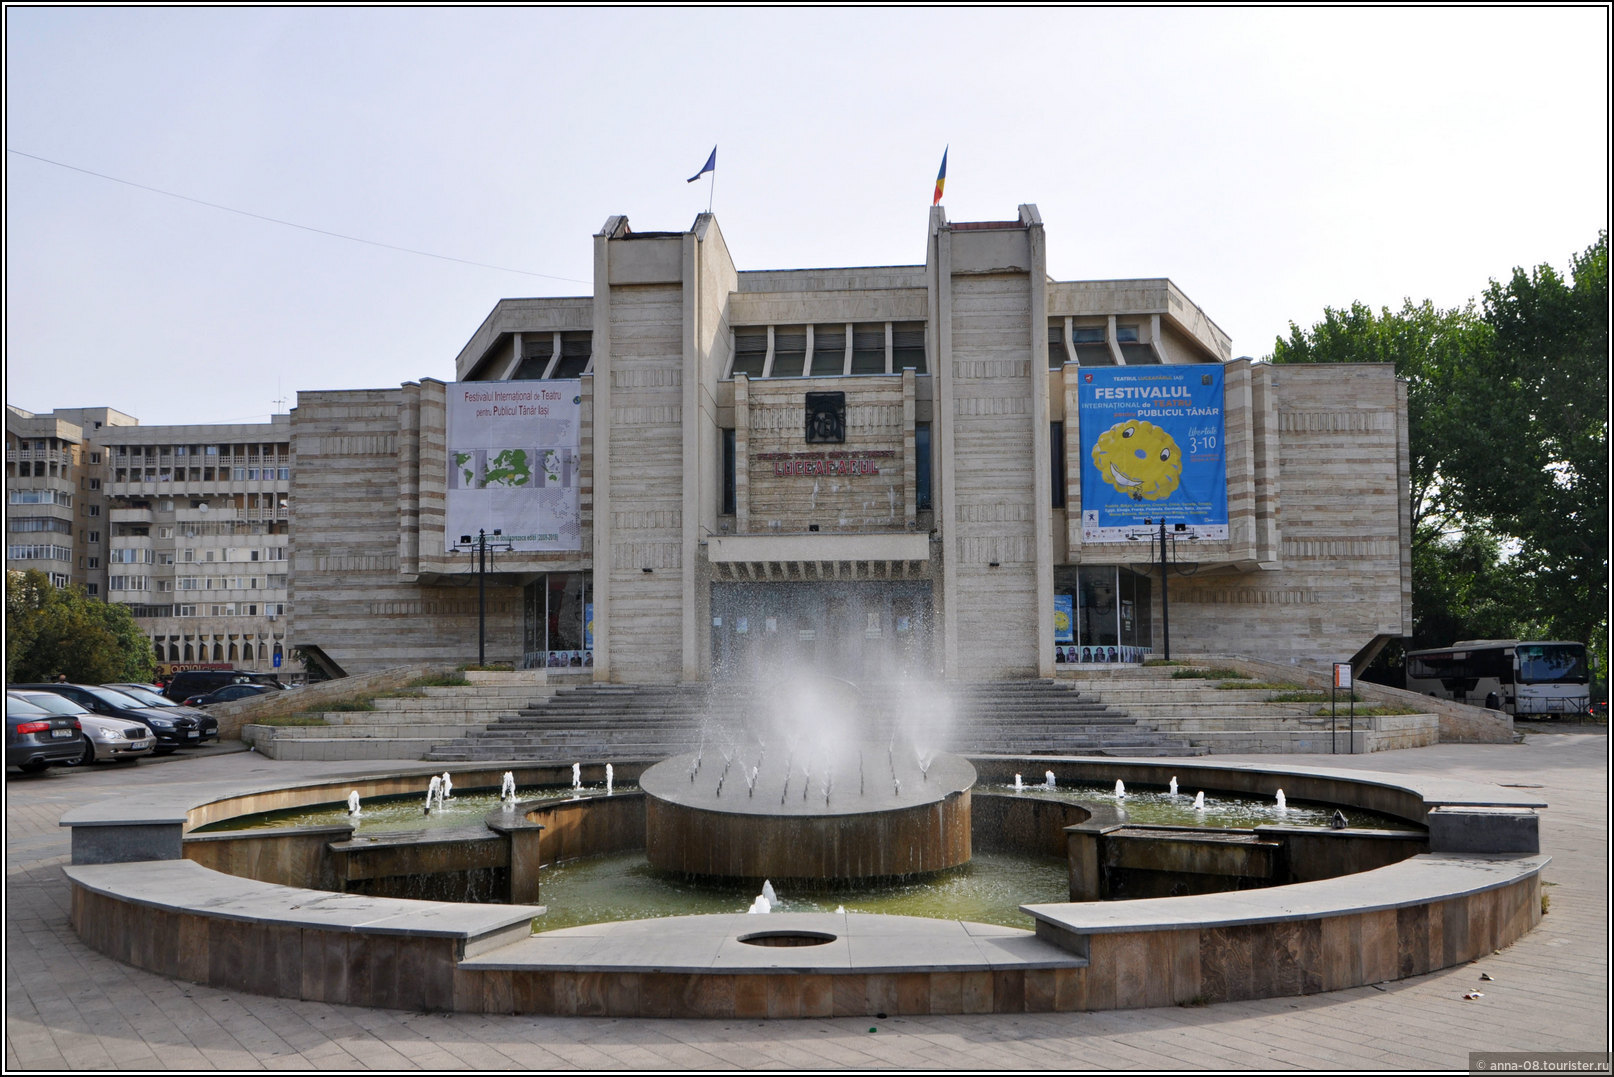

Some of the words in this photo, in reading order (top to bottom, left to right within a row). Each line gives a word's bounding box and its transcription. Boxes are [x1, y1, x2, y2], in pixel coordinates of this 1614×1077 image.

[464, 391, 493, 402] Festivalul
[541, 390, 561, 400] Teatru
[1095, 386, 1191, 399] FESTIVALUL
[1153, 399, 1192, 407] TEATRU
[476, 408, 492, 418] pentru
[493, 405, 517, 416] Publicul
[1137, 408, 1184, 417] PUBLICUL
[1190, 436, 1217, 454] 3-10
